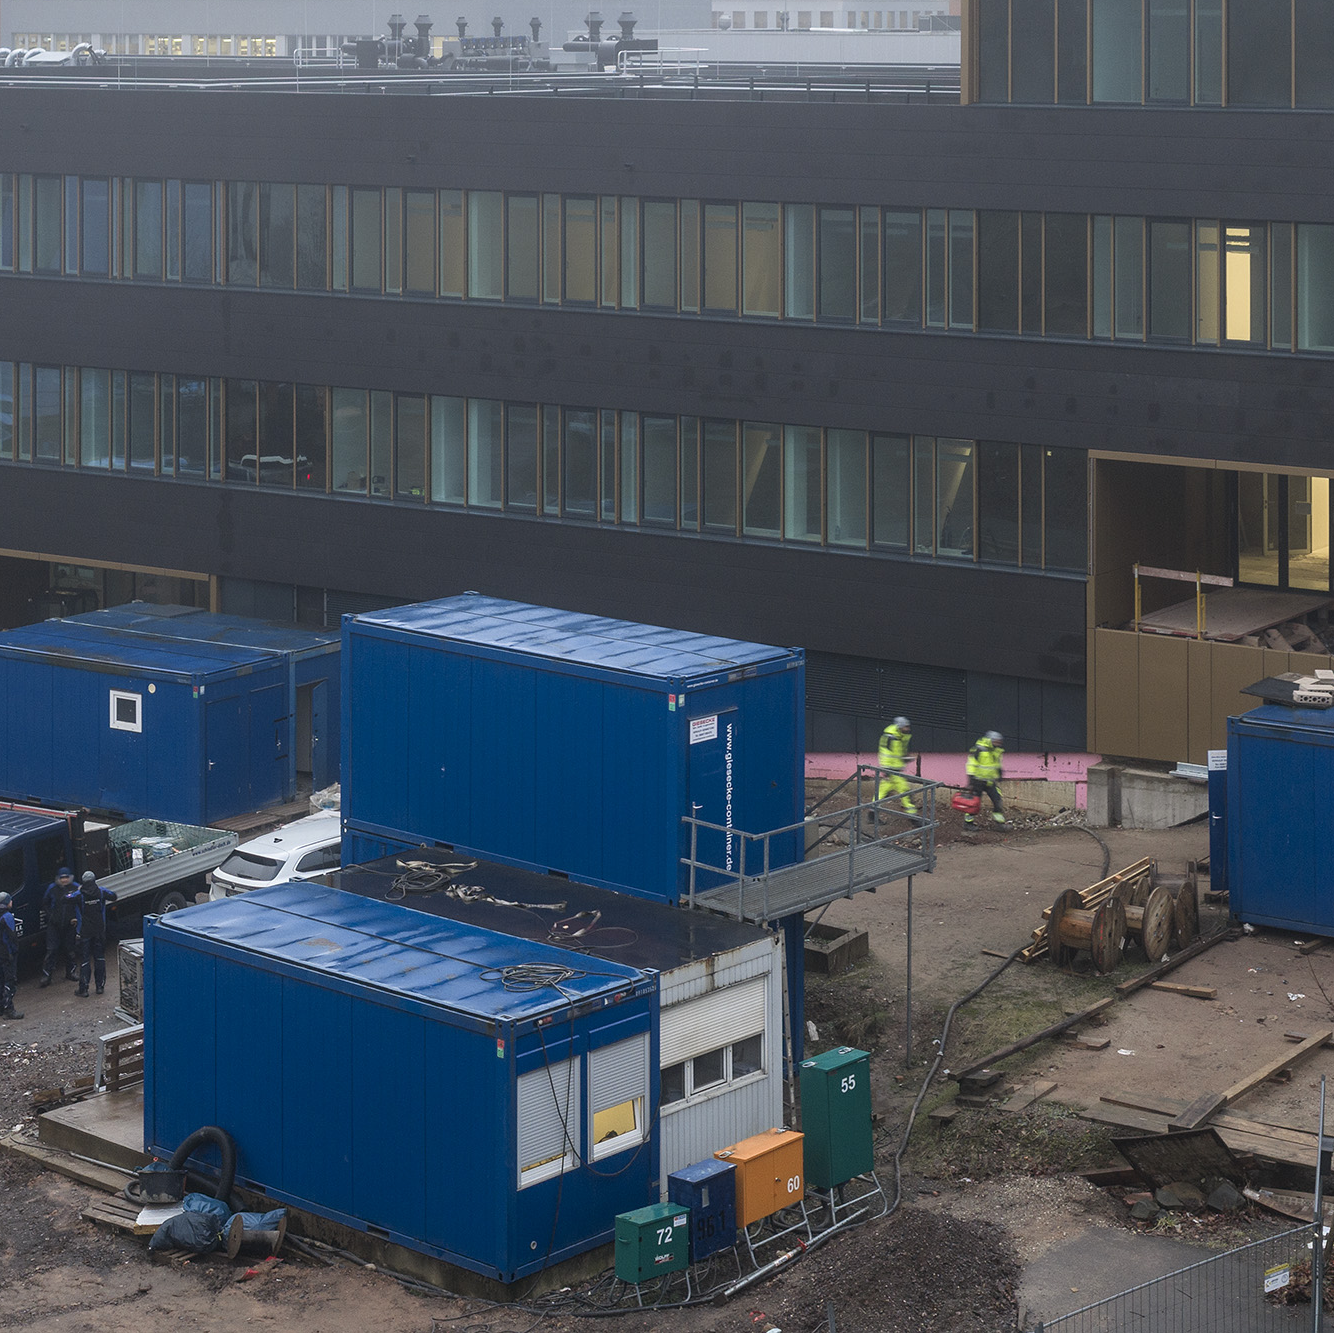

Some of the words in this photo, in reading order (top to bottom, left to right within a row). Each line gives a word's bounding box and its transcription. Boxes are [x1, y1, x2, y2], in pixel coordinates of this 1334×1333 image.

[725, 723, 733, 871] www.giesecke-continer.de
[841, 1074, 856, 1093] 55
[787, 1175, 800, 1193] 60
[656, 1226, 673, 1245] 72
